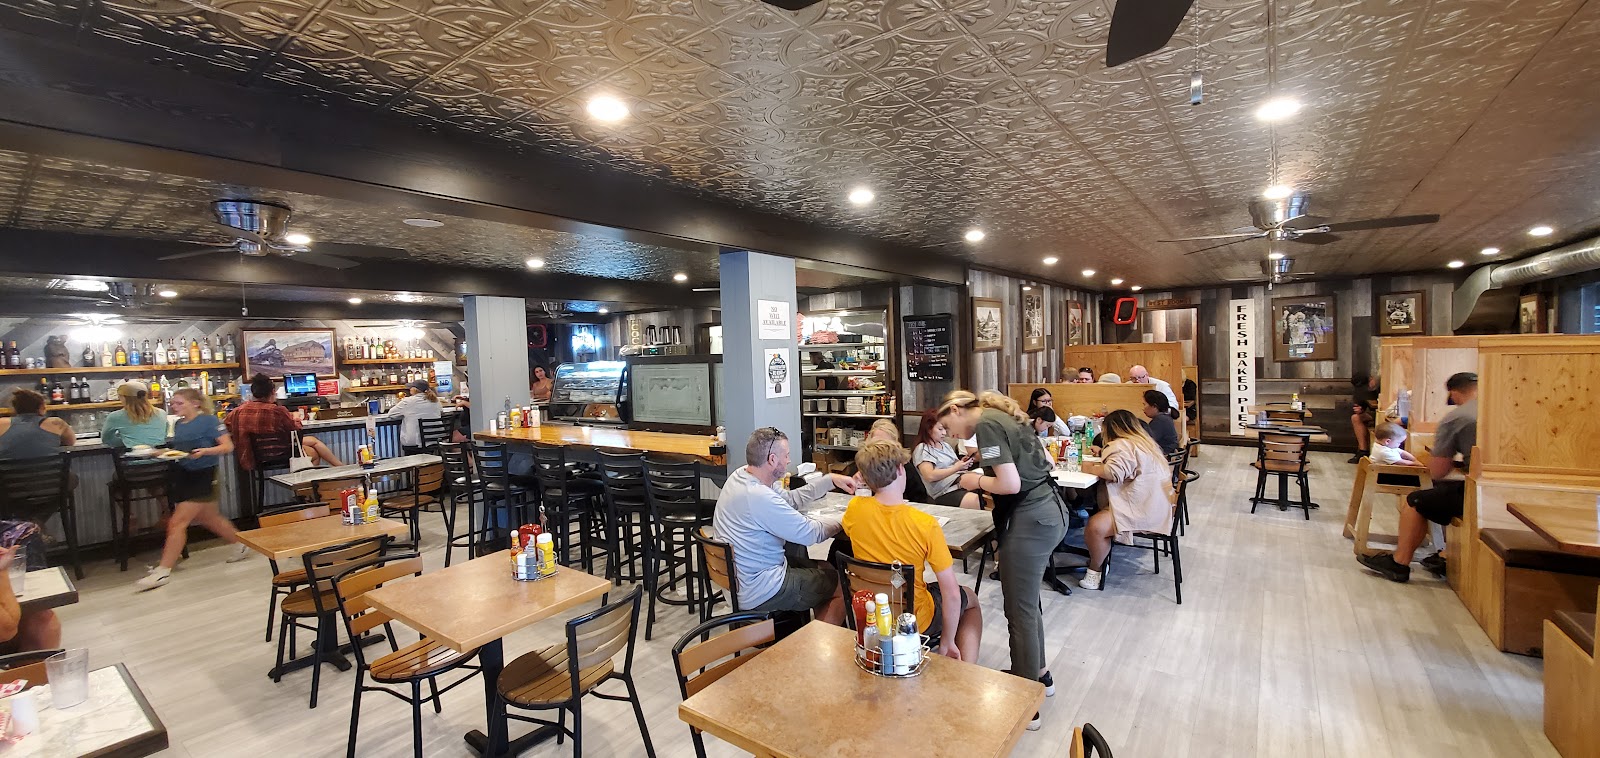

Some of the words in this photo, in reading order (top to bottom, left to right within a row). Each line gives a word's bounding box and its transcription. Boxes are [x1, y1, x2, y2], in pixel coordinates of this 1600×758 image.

[1236, 304, 1249, 346] FRESH
[1237, 351, 1249, 392] BAKED
[1237, 397, 1249, 430] PIES
